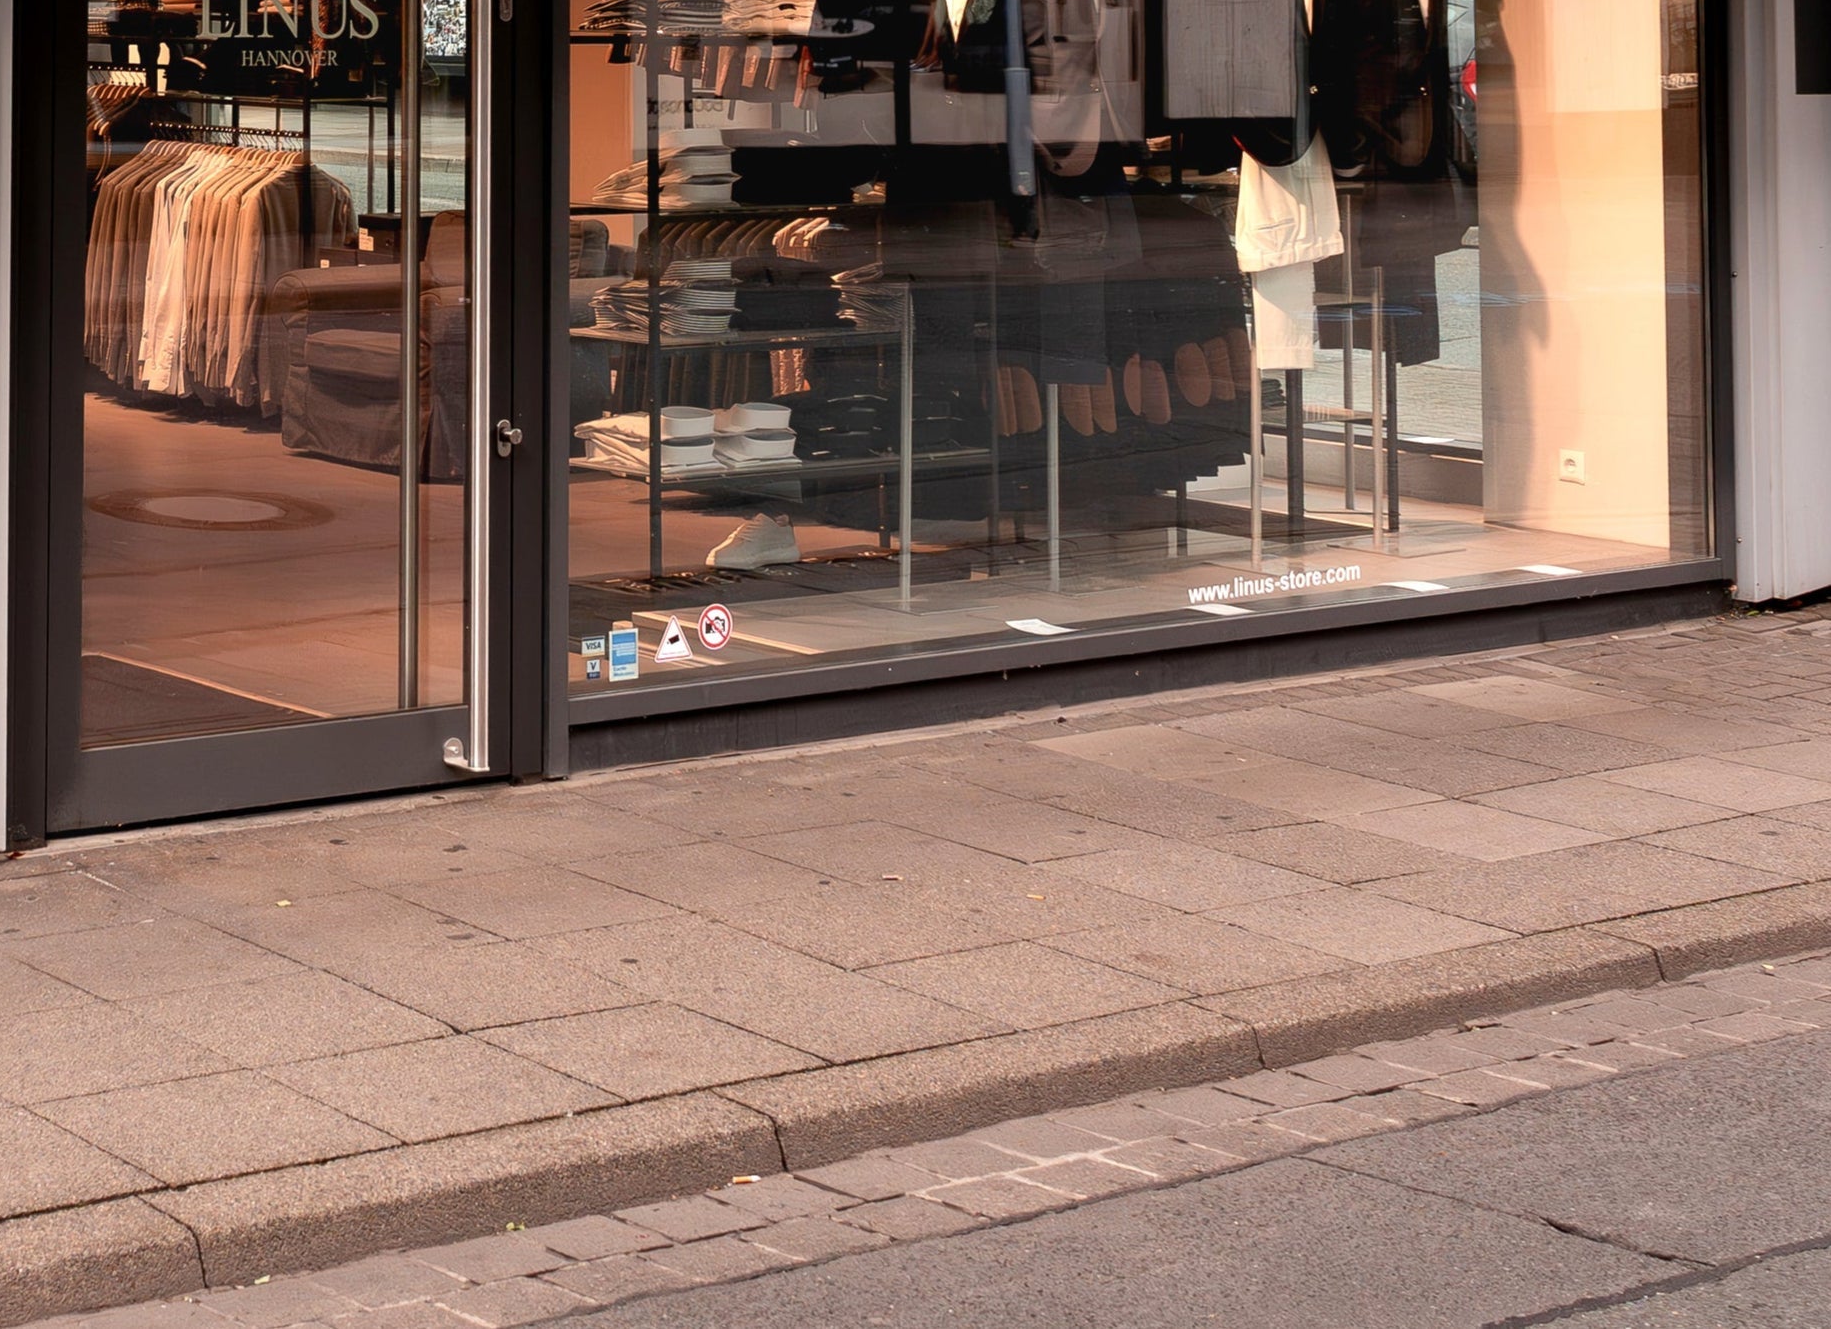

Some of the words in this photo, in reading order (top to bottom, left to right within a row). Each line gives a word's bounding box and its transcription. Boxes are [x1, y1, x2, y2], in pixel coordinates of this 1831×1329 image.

[241, 49, 339, 68] HANNOVER
[1187, 564, 1362, 604] www.linus-store.com
[585, 641, 602, 650] VISA
